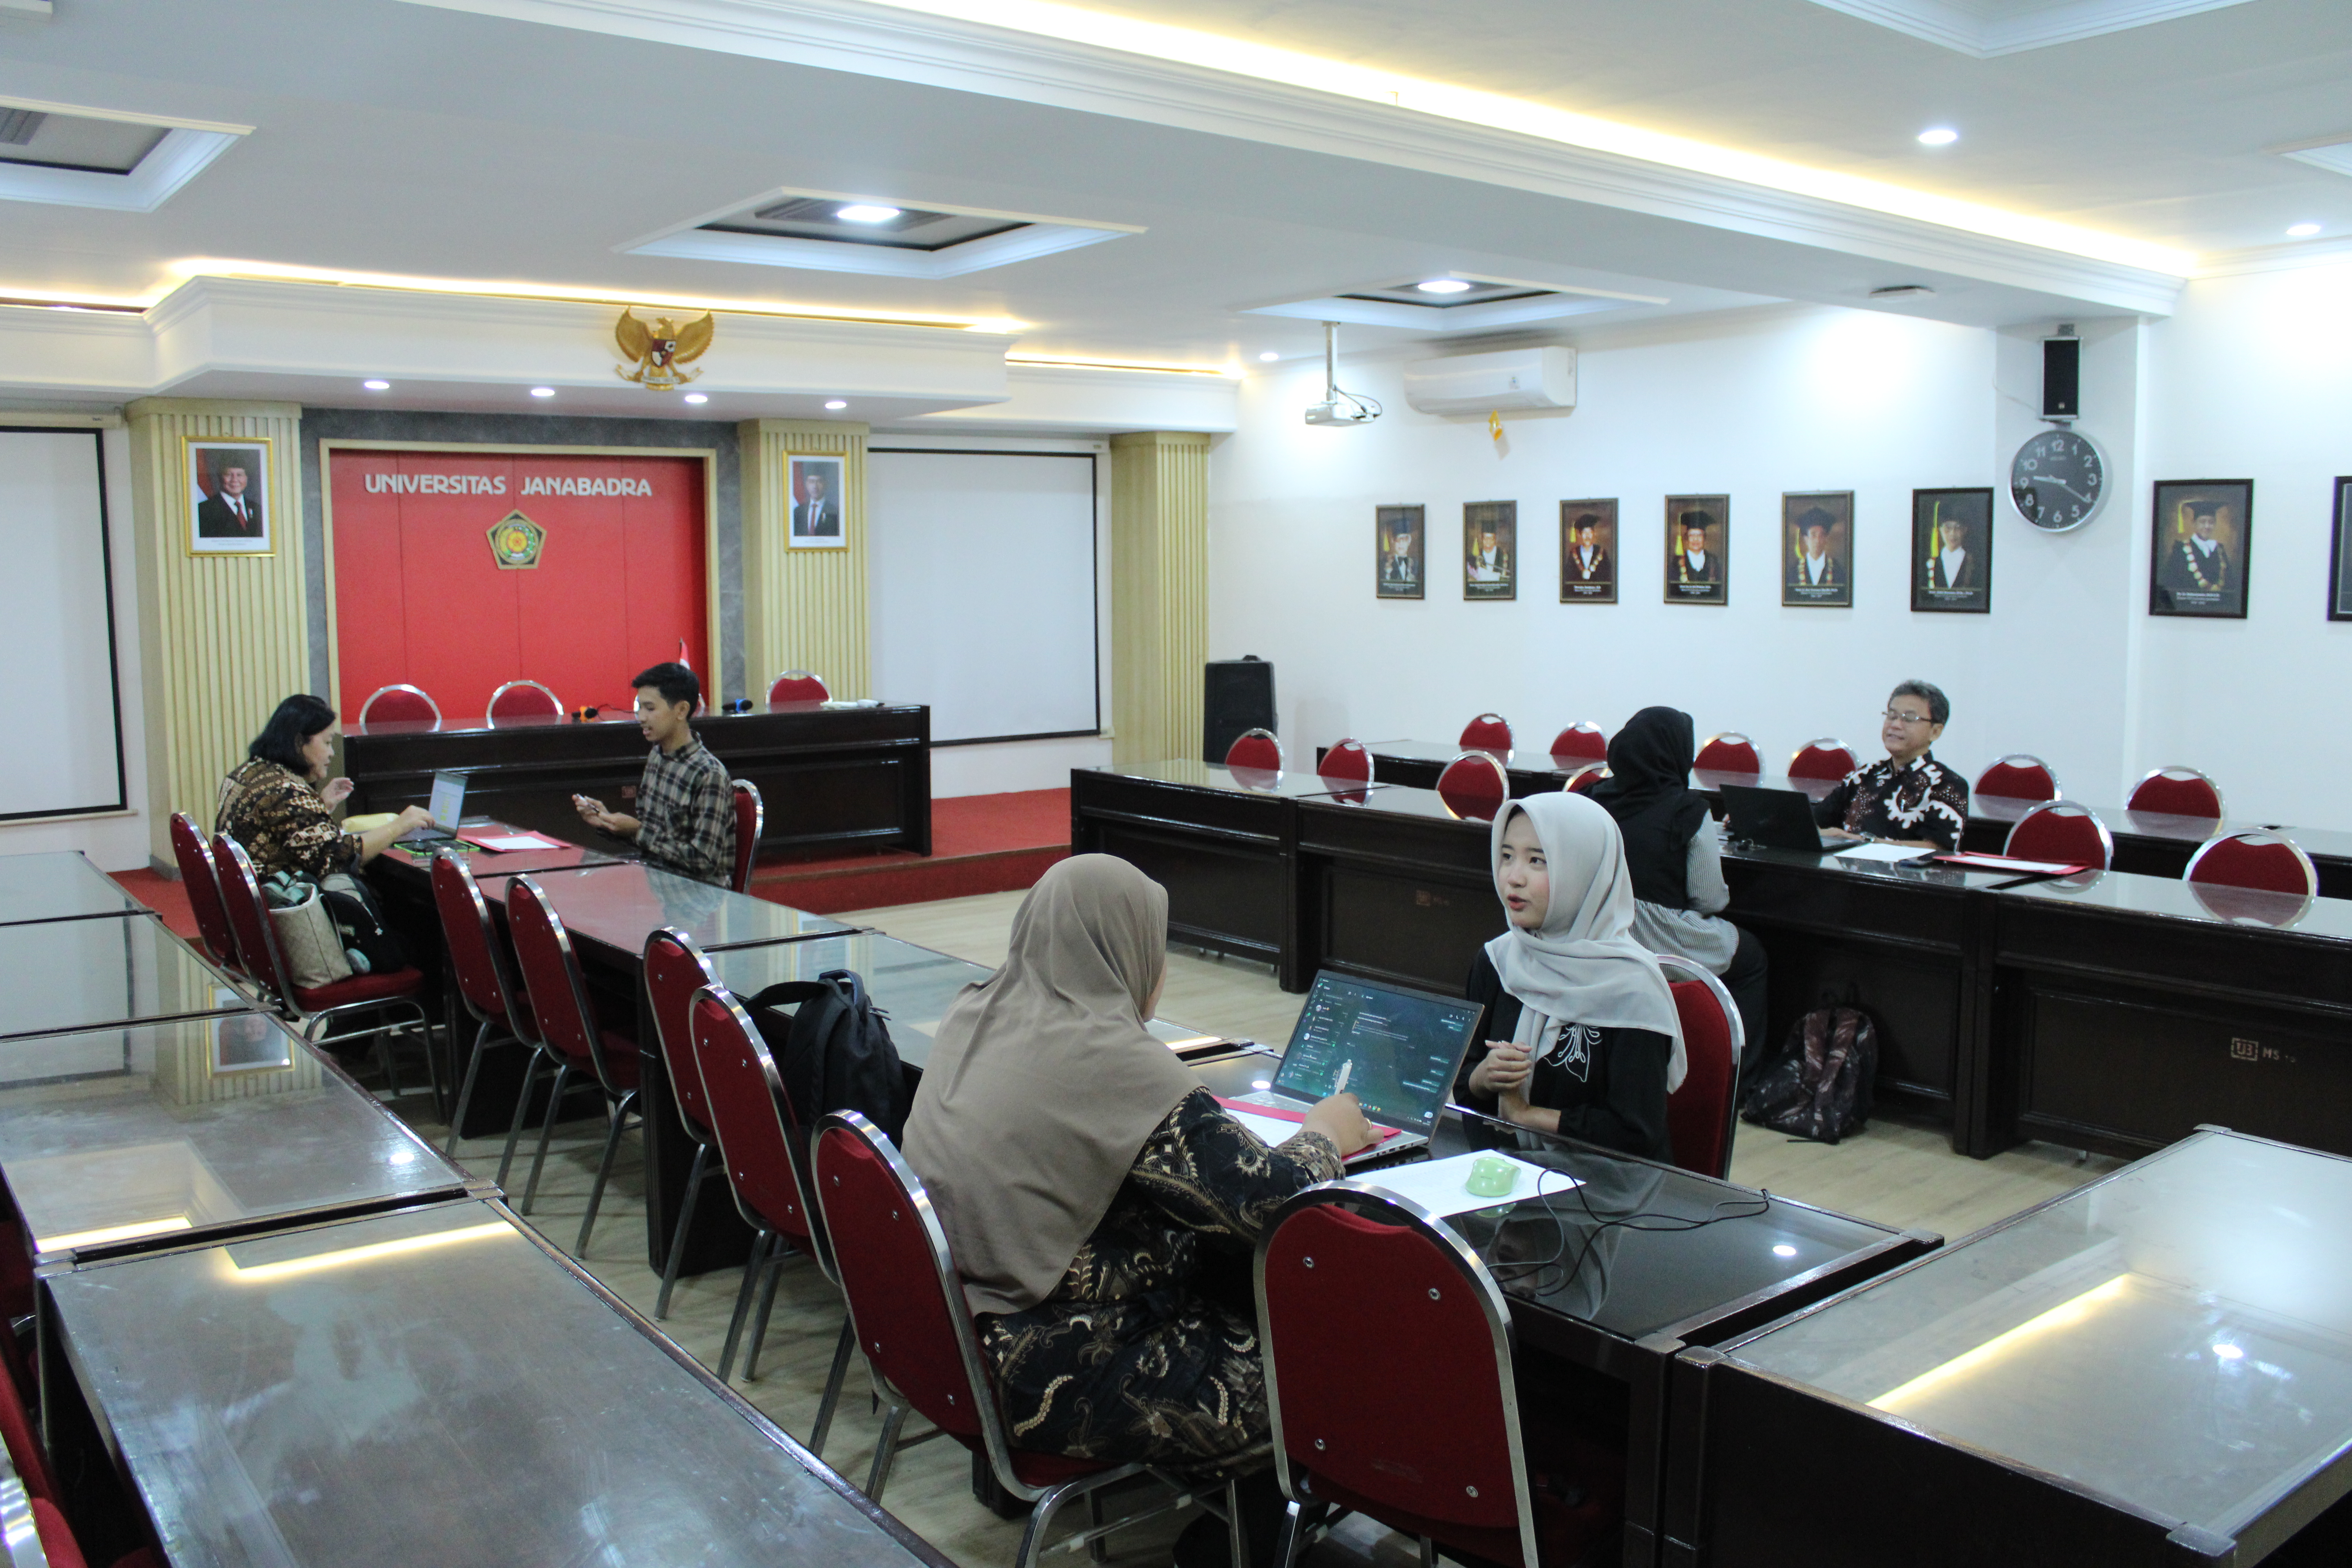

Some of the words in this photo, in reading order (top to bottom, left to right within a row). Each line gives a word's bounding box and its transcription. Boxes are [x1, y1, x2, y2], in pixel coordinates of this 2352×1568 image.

[2036, 445, 2046, 457] 11
[2052, 439, 2065, 452] 12
[2072, 443, 2078, 456] 1
[2023, 458, 2038, 471] 10
[2084, 455, 2093, 467] 2
[365, 474, 506, 495] UNIVERSITAS
[521, 477, 653, 496] JANABADRA
[2019, 477, 2029, 490] 9
[2087, 473, 2098, 486] 3
[2025, 494, 2034, 507] 8
[2038, 506, 2045, 519] 7
[2053, 510, 2063, 523] 6
[2071, 505, 2080, 518] 5
